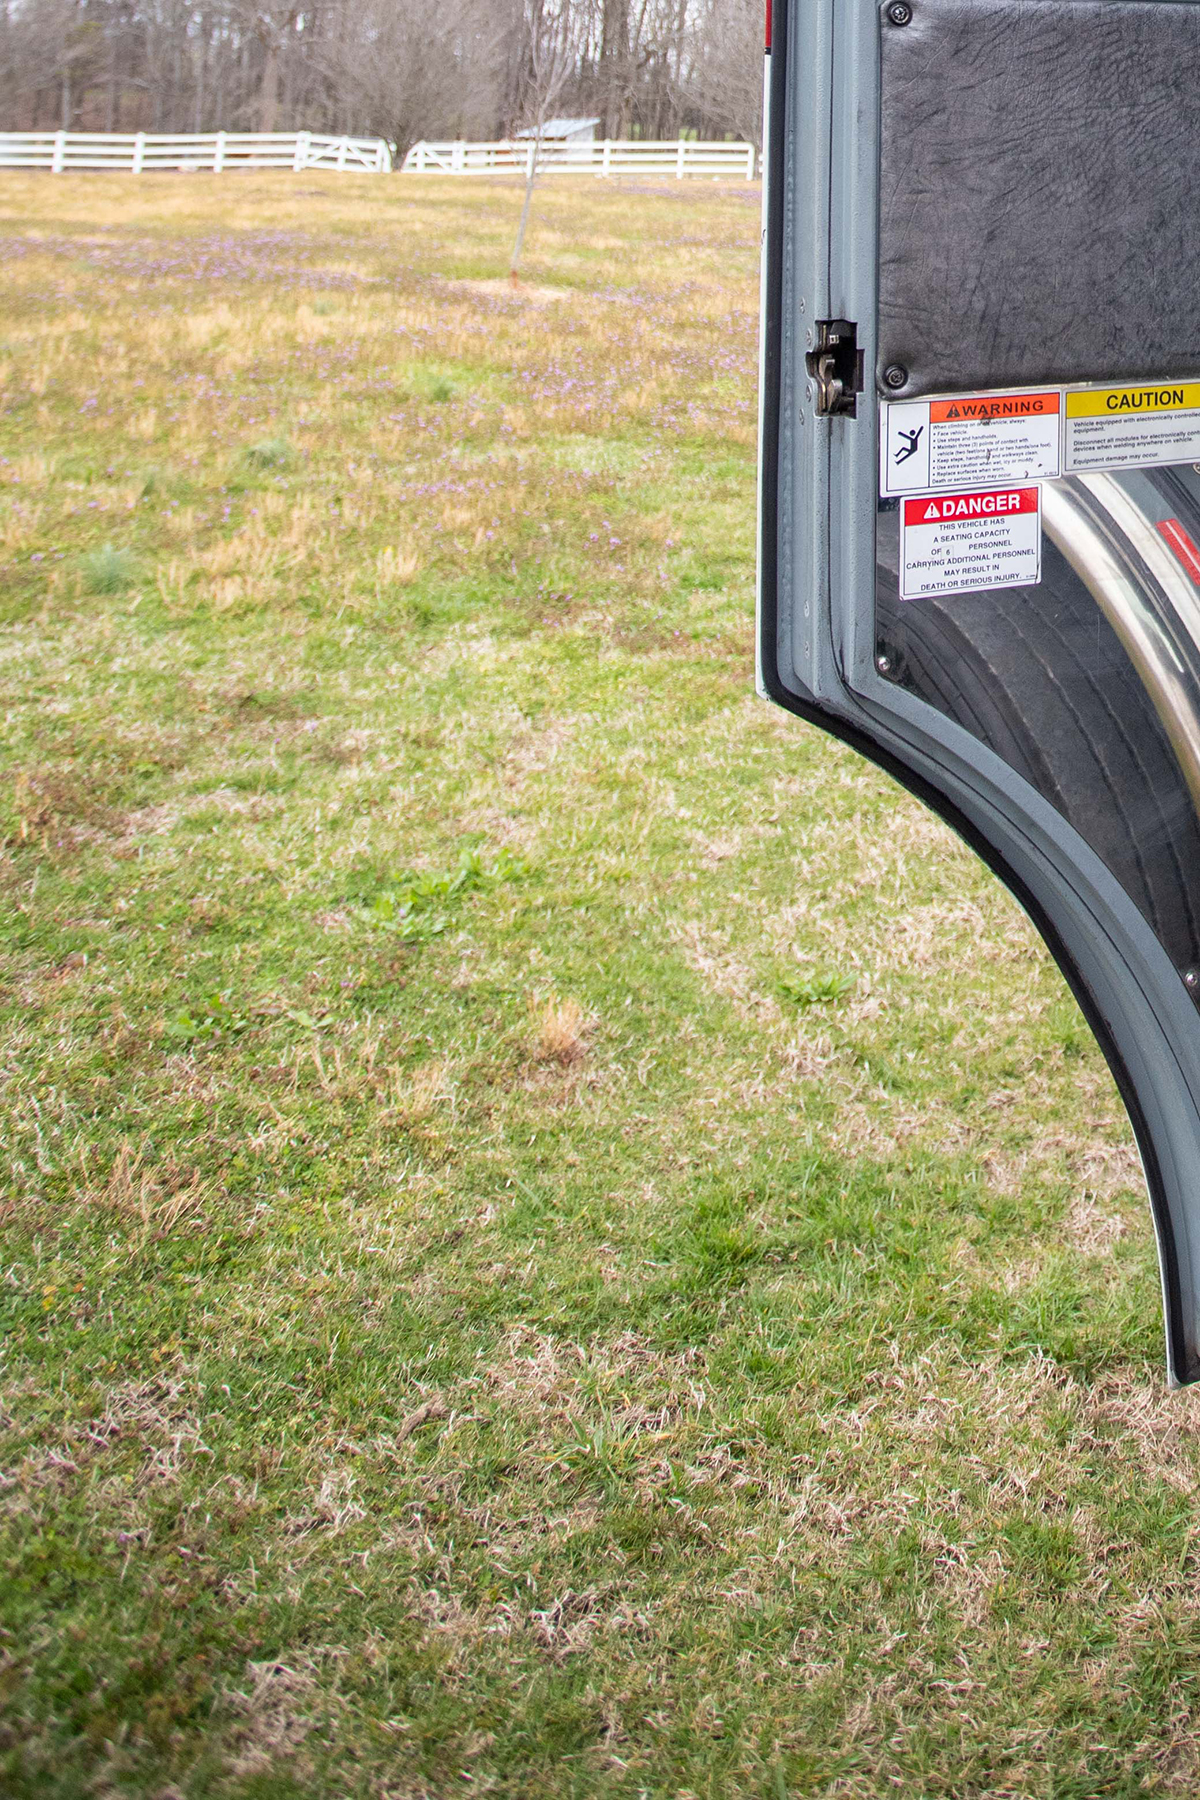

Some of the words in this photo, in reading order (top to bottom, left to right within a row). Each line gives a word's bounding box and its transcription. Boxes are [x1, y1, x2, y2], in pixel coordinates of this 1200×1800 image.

[1107, 390, 1184, 409] CAUTION
[962, 400, 1043, 415] WARNING
[1095, 419, 1122, 427] equipped
[1137, 414, 1173, 423] electronically
[1150, 431, 1186, 440] electronically
[1114, 442, 1135, 450] welding
[1106, 455, 1128, 463] damage
[942, 494, 1020, 516] DANGER
[957, 521, 988, 530] VEHICLE
[990, 518, 1005, 526] HAS
[940, 533, 972, 543] SEATING
[974, 528, 1011, 538] CAPACITY
[968, 540, 1012, 550] PERSONNEL
[906, 559, 944, 569] CARRYING
[947, 553, 990, 564] ADDITIONAL
[993, 549, 1035, 559] PERSONNEL
[962, 566, 991, 574] RESULT
[921, 583, 945, 591] DEATH
[960, 577, 992, 586] SERIOUS
[994, 573, 1021, 582] INJURY.
